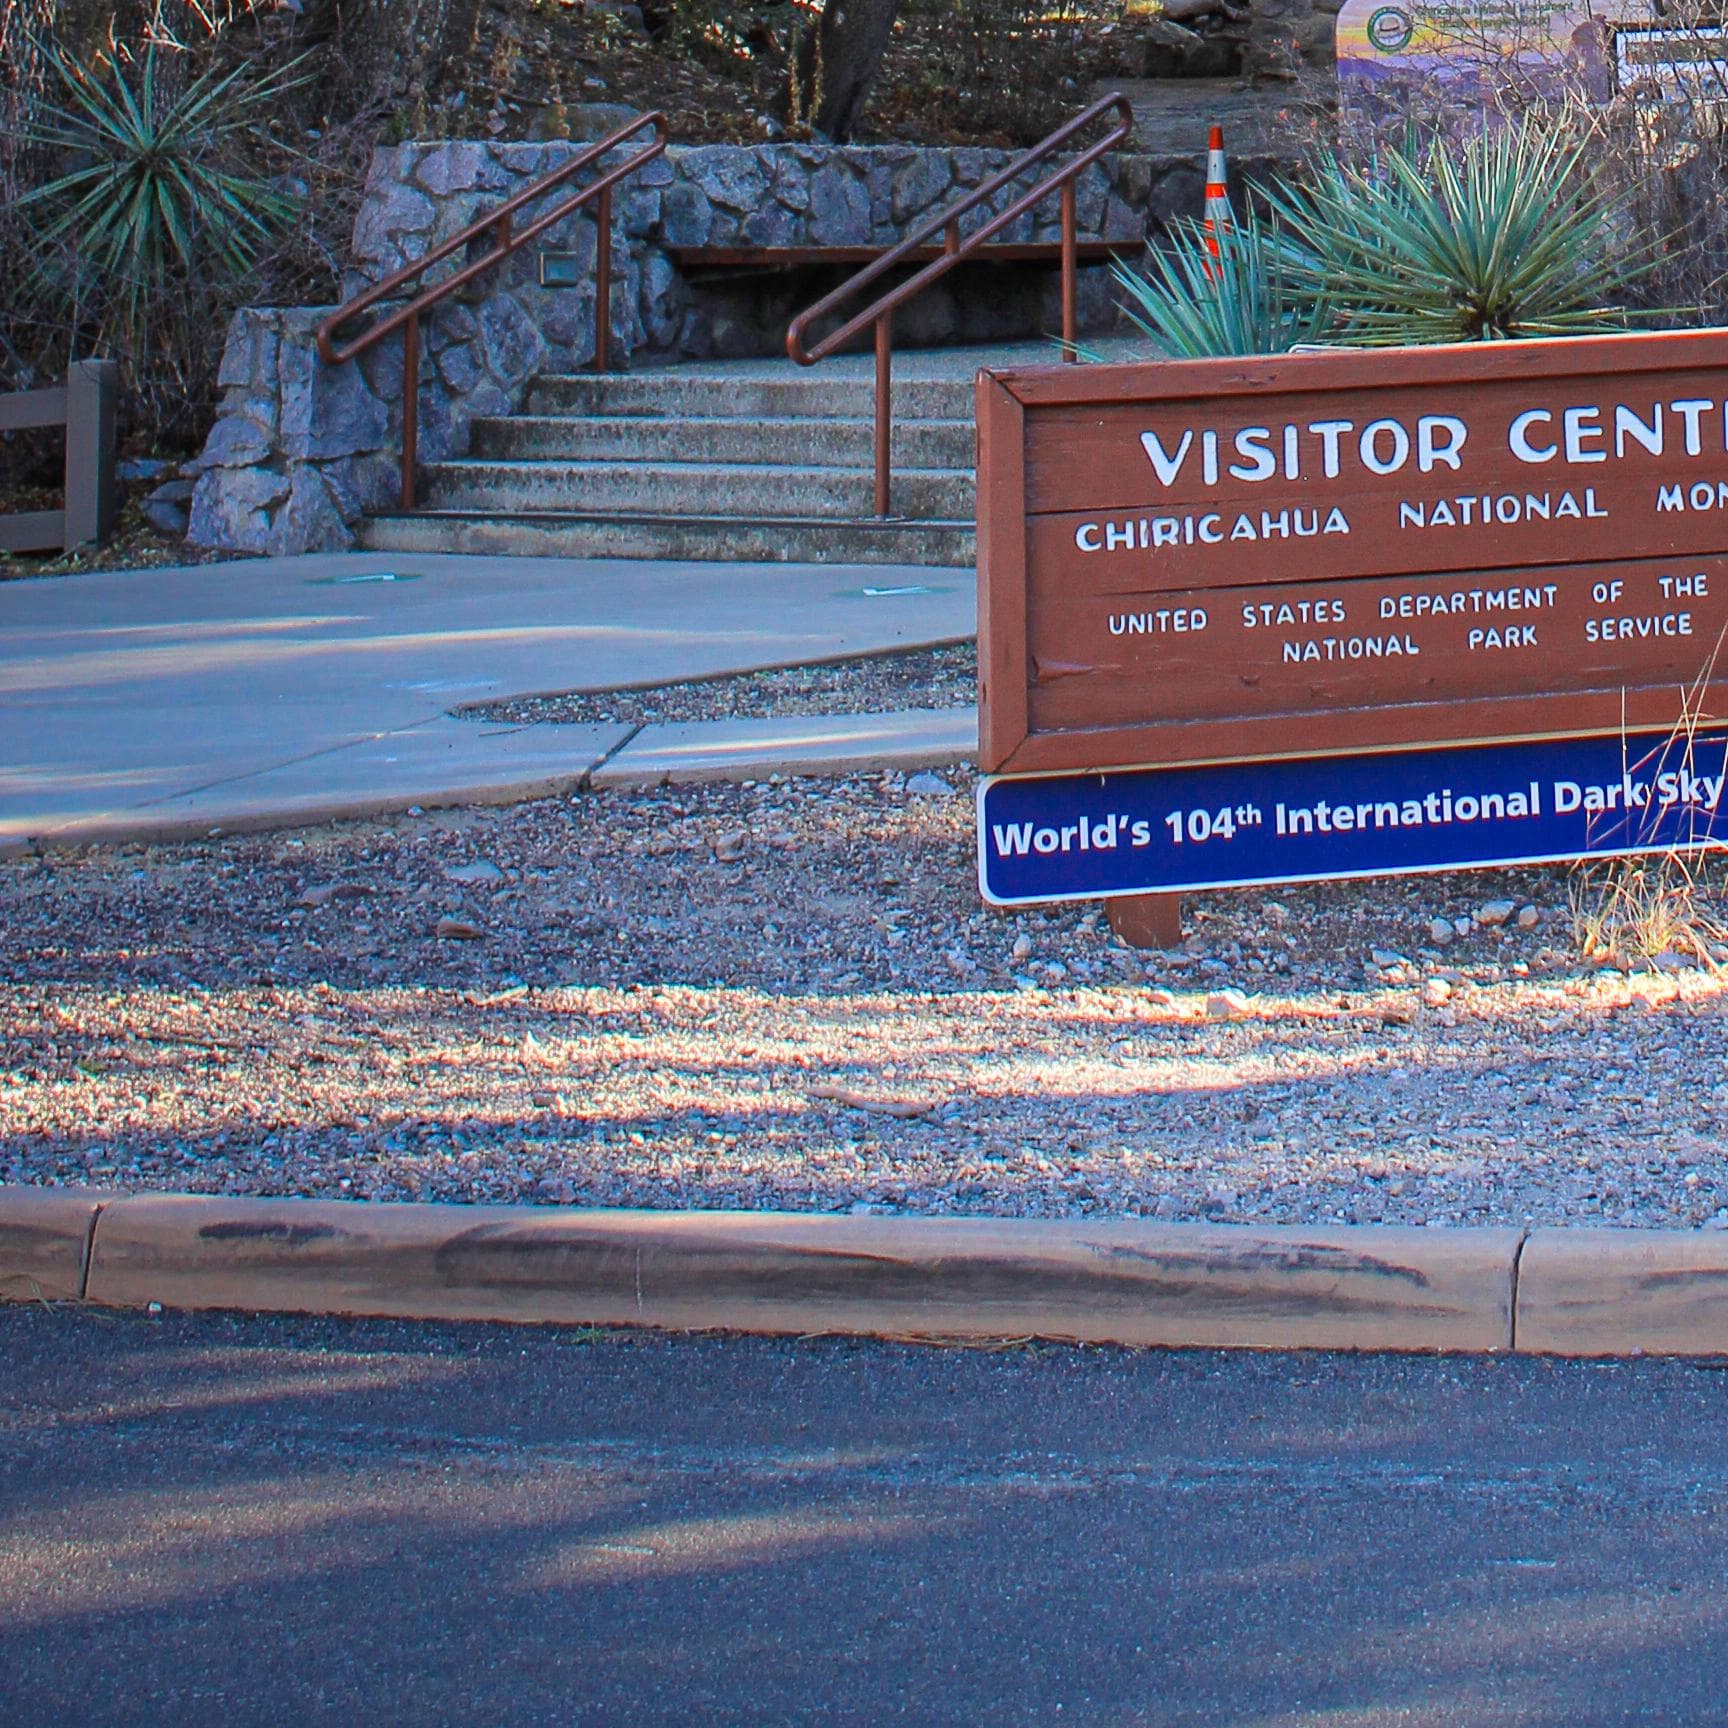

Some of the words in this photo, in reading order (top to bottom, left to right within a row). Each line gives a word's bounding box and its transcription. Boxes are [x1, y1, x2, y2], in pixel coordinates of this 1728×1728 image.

[1140, 415, 1468, 487] VISITOR
[1075, 507, 1350, 552] CHIRICAHUA
[1400, 487, 1609, 528] NATIONAL
[1108, 608, 1208, 636] UNITED
[1242, 600, 1346, 628] STATES
[1379, 585, 1558, 619] DEPARTMENT
[1592, 580, 1624, 604] OF
[1658, 574, 1709, 599] THE
[1282, 634, 1420, 663] NATIONAL
[1468, 625, 1538, 650] PARK
[1585, 613, 1693, 642] SERVICE
[992, 813, 1151, 857] World's
[1164, 802, 1262, 843] 104th
[1275, 781, 1540, 835] International
[1553, 773, 1648, 814] Dark
[1657, 768, 1725, 809] Sky
